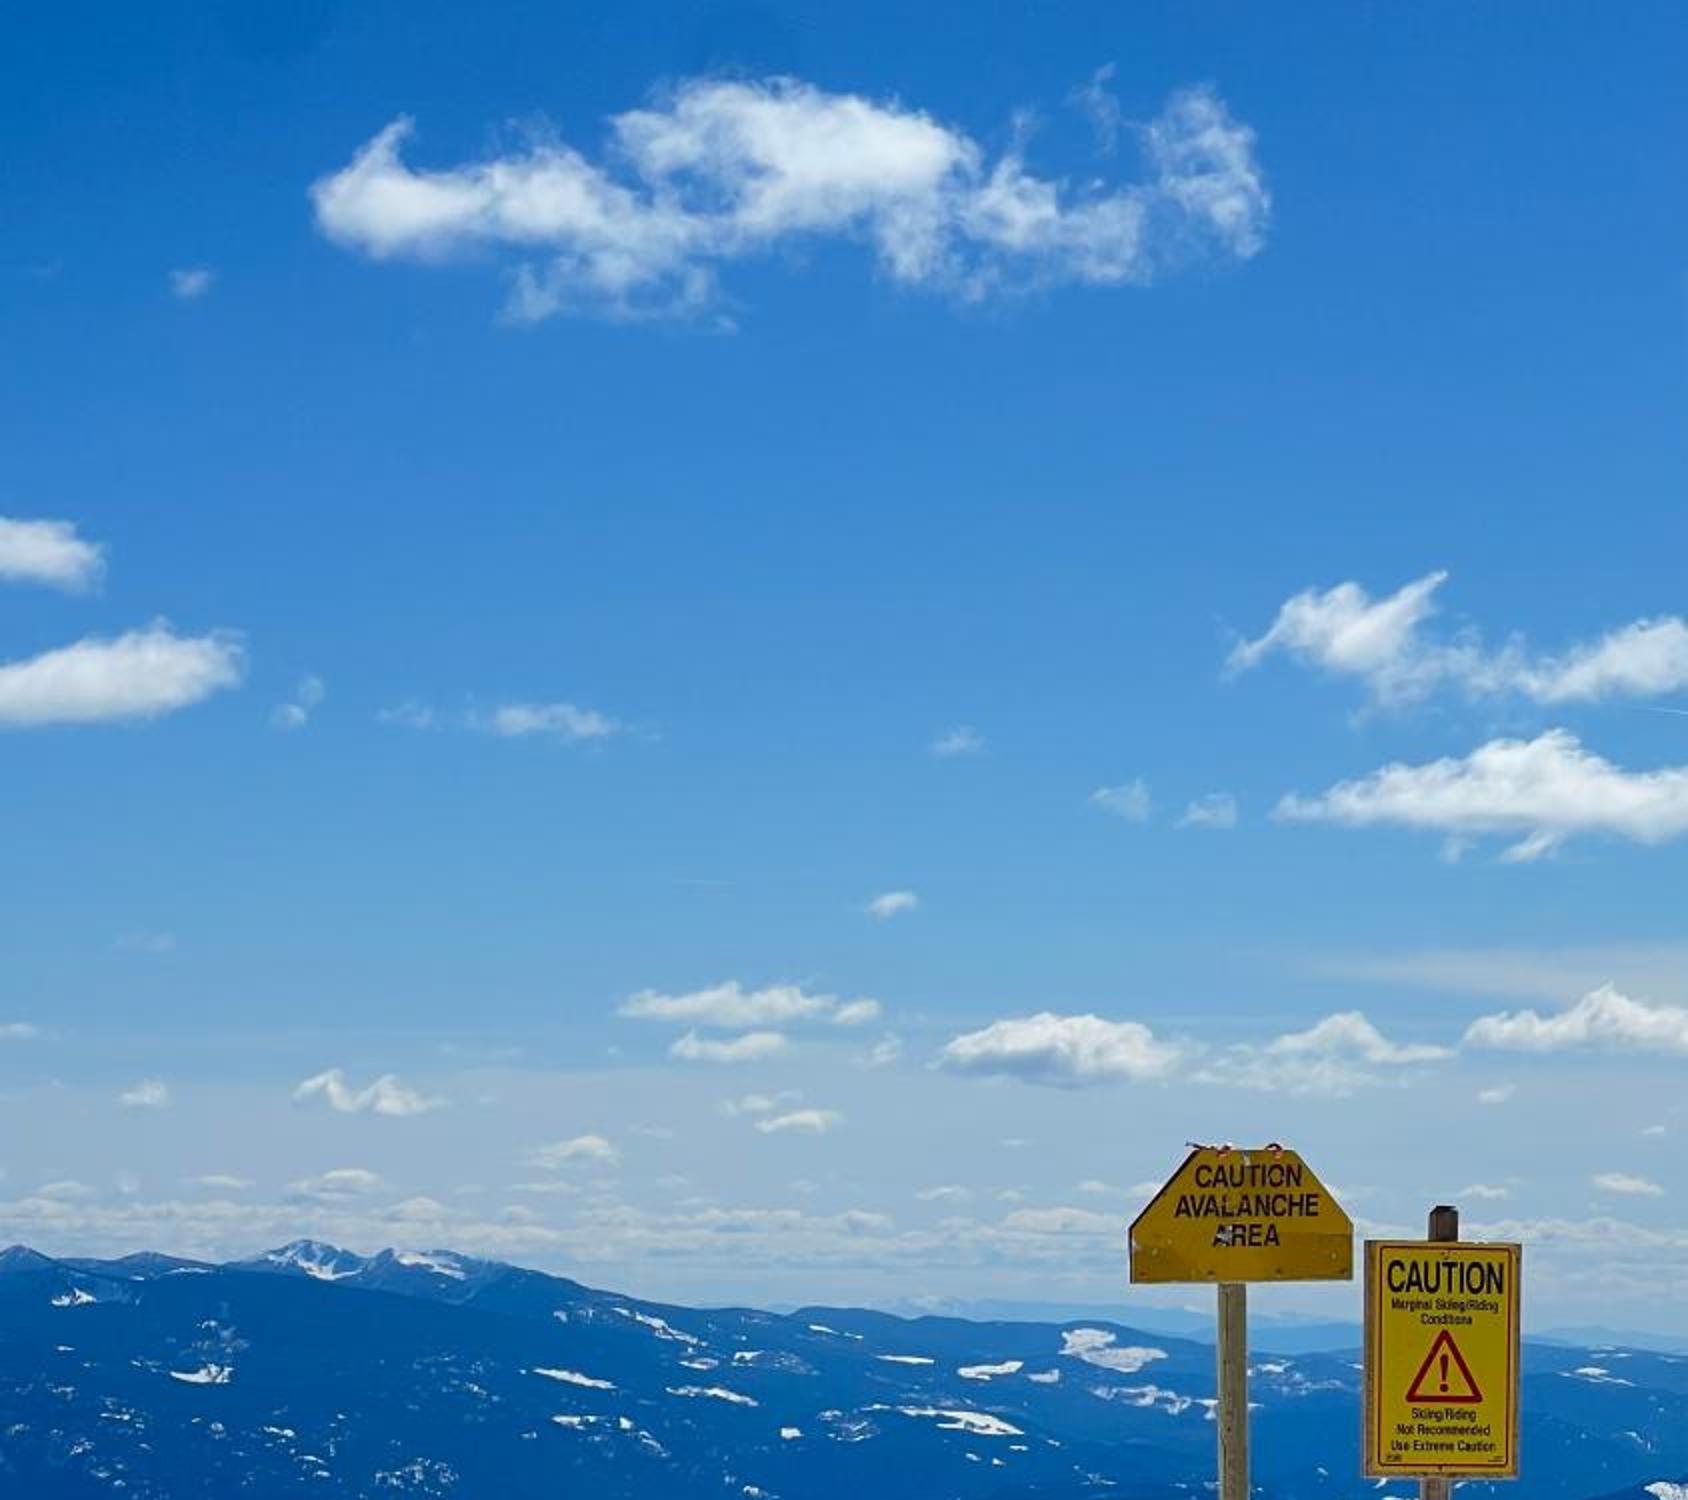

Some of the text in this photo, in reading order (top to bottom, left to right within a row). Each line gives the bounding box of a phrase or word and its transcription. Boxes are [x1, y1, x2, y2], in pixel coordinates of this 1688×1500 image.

[1195, 1164, 1301, 1187] CAUTION
[1175, 1194, 1319, 1217] AVALANCHE
[1213, 1223, 1280, 1247] AREA
[1387, 1260, 1504, 1294] CAUTION
[1421, 1314, 1472, 1324] Conditions
[1397, 1423, 1491, 1436] Not Recommended
[1391, 1440, 1495, 1452] Use Extreme Caution
